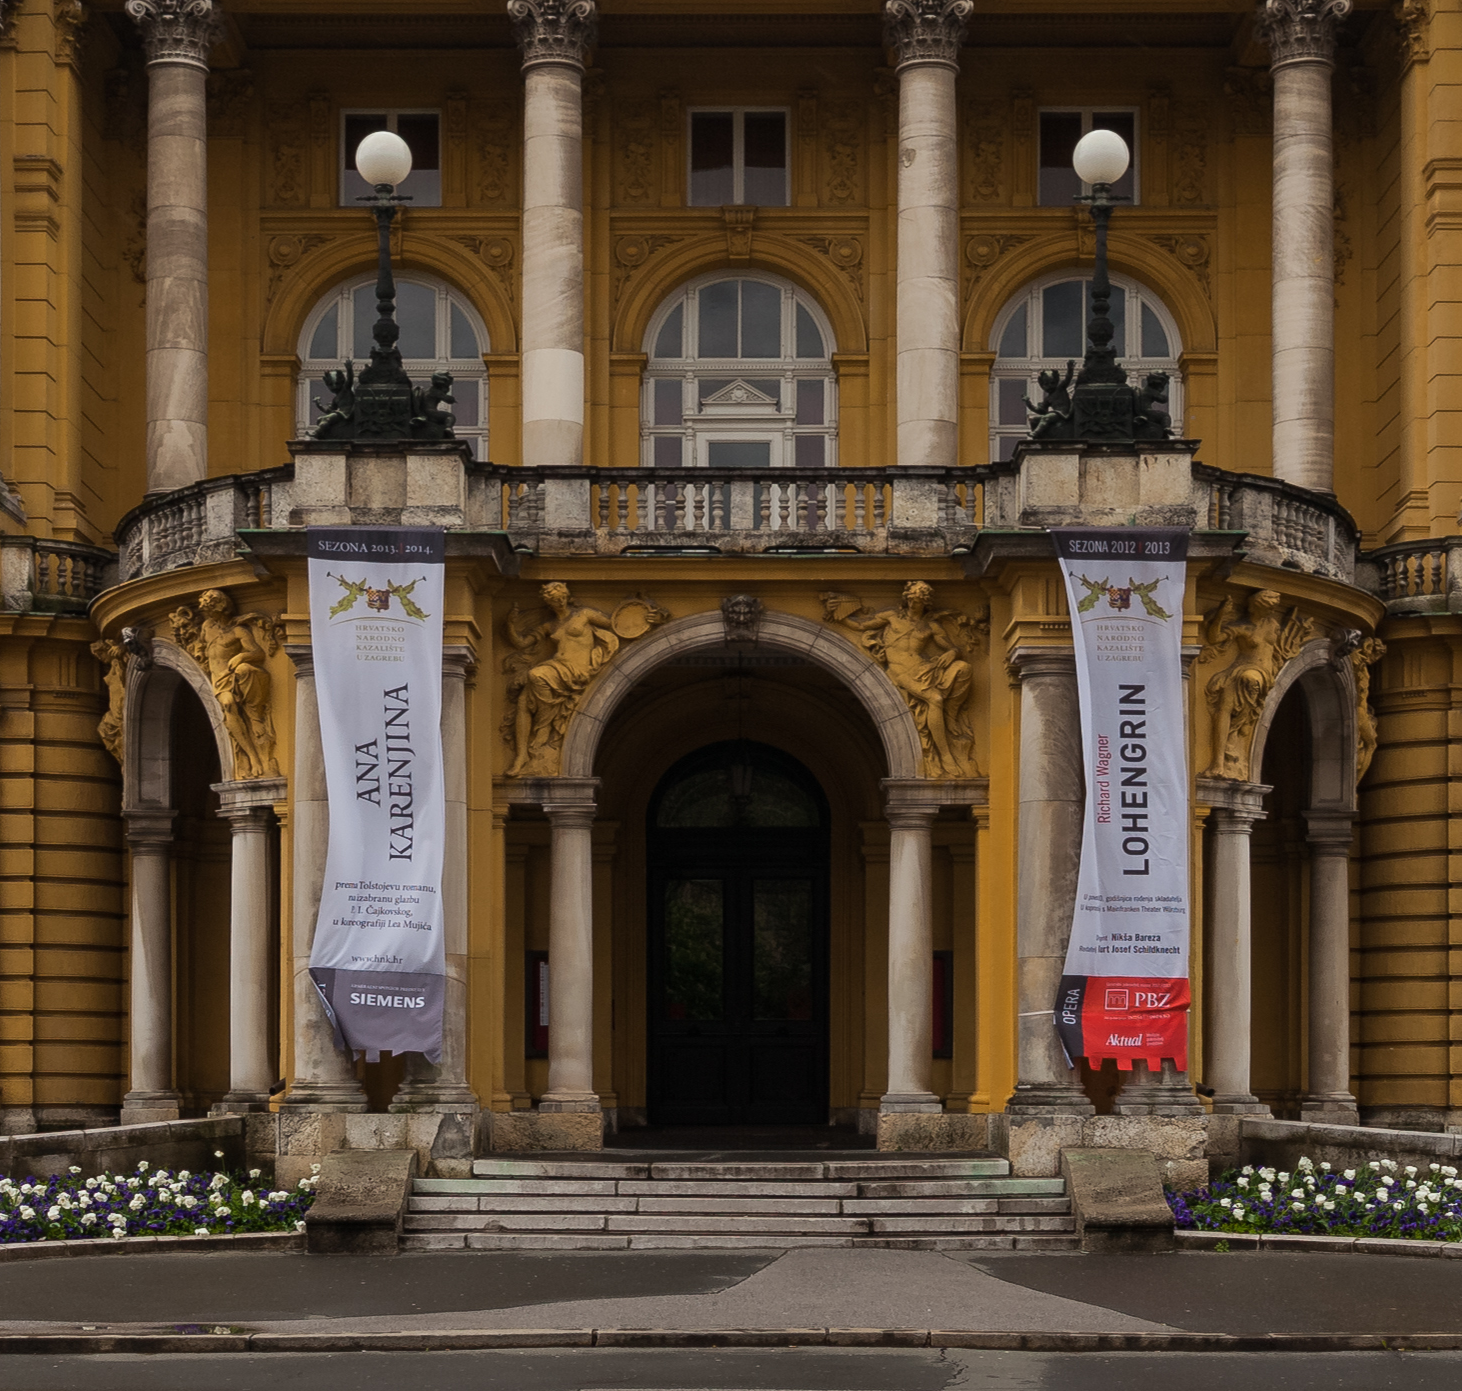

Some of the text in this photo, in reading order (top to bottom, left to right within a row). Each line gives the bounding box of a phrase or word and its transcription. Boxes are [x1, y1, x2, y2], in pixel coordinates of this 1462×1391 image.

[318, 540, 433, 555] SEZONA 2013. 2014.
[1069, 540, 1171, 554] SEZONA 2012 2013
[355, 625, 405, 633] HRVATSKO
[356, 644, 405, 652] KAZALIŠTE
[1096, 644, 1144, 652] KAZALIŠTE
[355, 738, 381, 808] ANA
[383, 682, 417, 862] KARENJINA
[1096, 733, 1112, 825] Richard Wagner
[1118, 684, 1150, 876] LOHENGRIN
[359, 881, 400, 892] Tolstojevu
[388, 920, 401, 928] Lea
[1111, 933, 1133, 942] Nikša
[1135, 934, 1161, 942] Bareza
[1111, 945, 1131, 954] Josef
[1133, 945, 1181, 955] Schildknecht
[350, 993, 425, 1009] SIEMENS
[1061, 988, 1080, 1025] OPERA
[1134, 992, 1171, 1008] PBZ
[1105, 1033, 1143, 1047] Aktual
